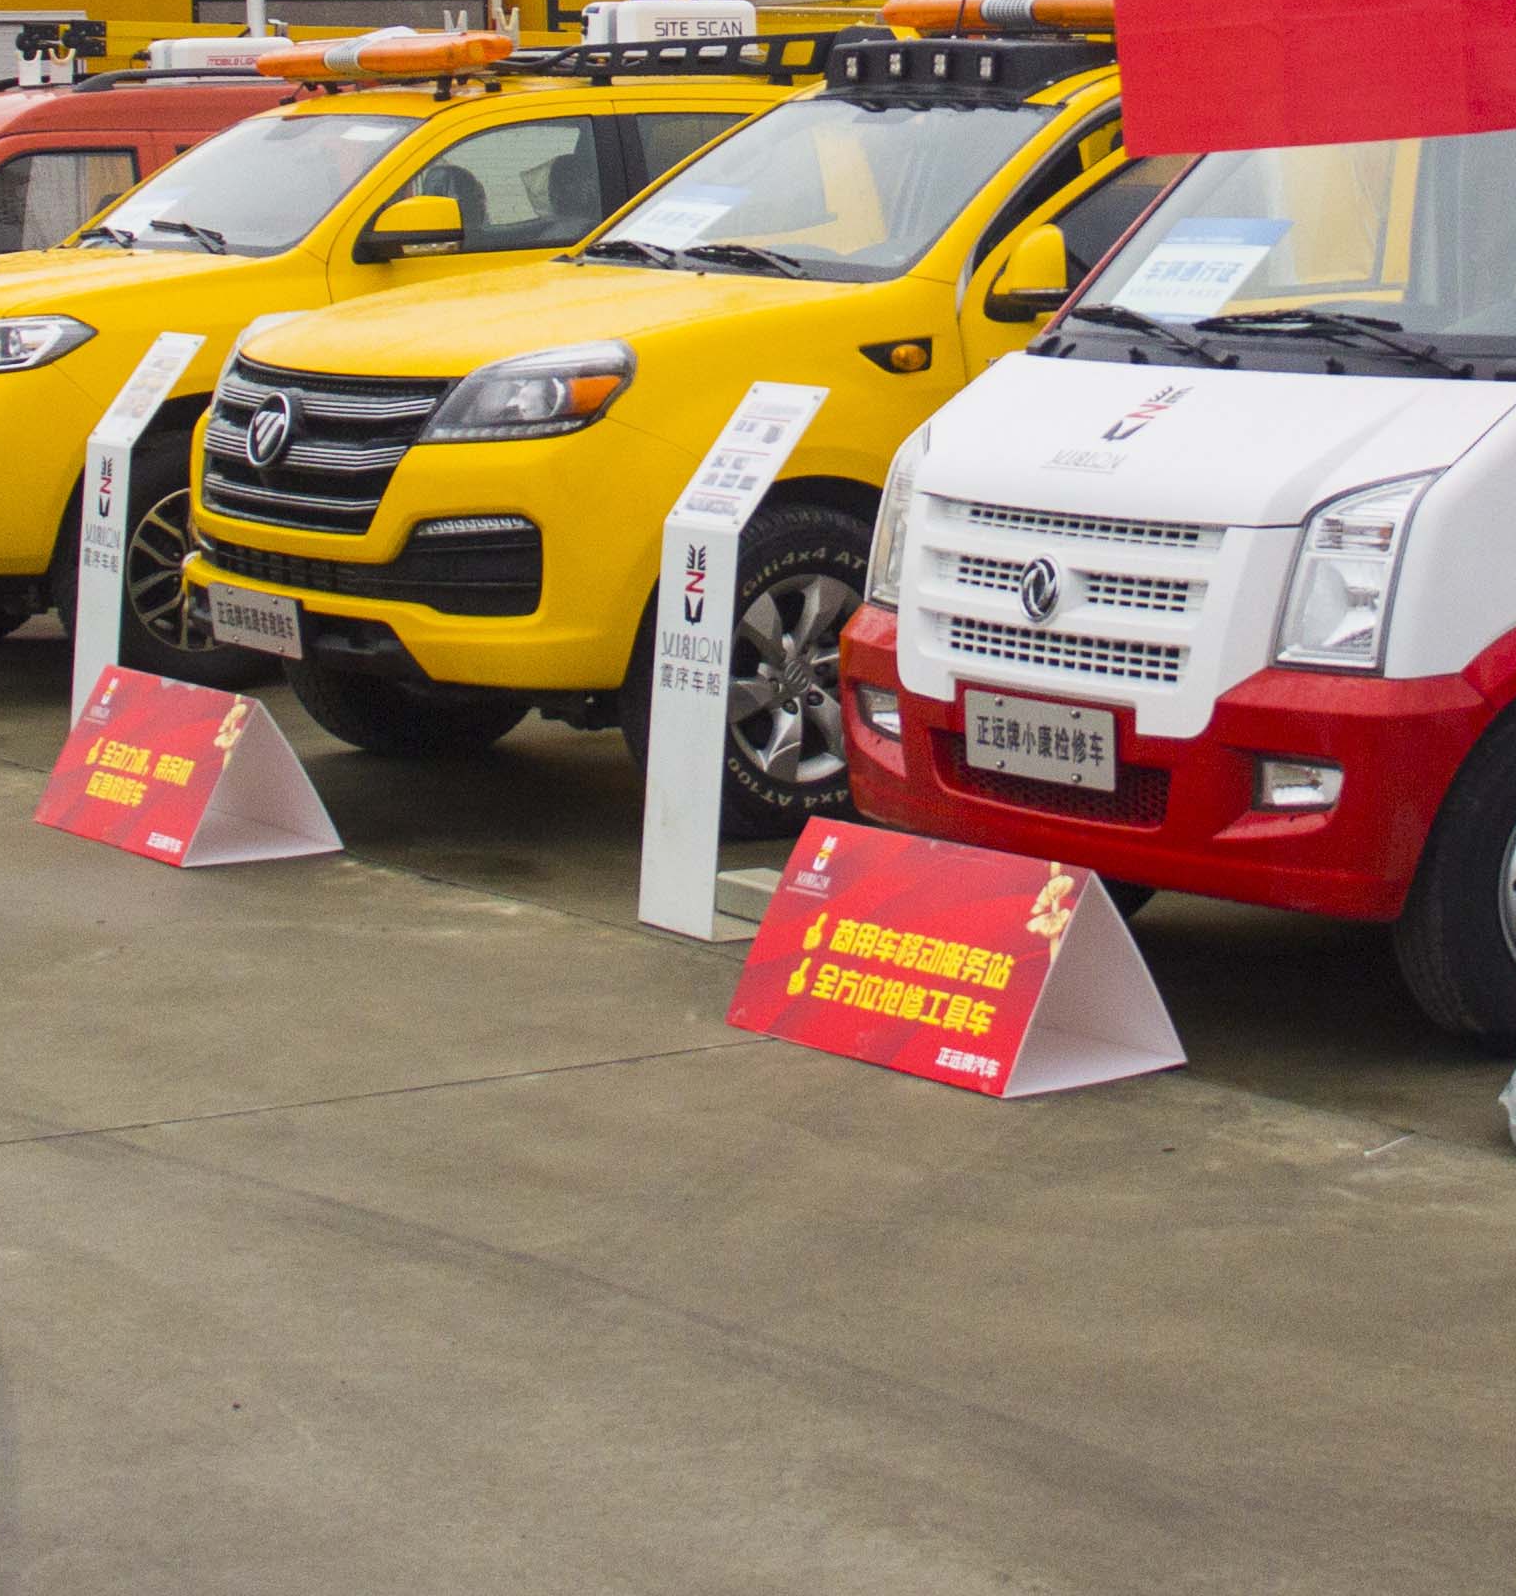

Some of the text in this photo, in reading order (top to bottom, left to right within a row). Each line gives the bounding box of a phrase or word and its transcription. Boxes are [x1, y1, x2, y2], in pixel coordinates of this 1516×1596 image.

[655, 20, 743, 37] SITE SCAN
[660, 663, 721, 696] 震序车船
[976, 715, 1105, 767] 正远牌小康检修车
[828, 918, 1016, 991] 商用车移动服务站
[810, 962, 997, 1036] 全方位抢修工具车
[935, 1046, 1001, 1078] 正远牌汽车
